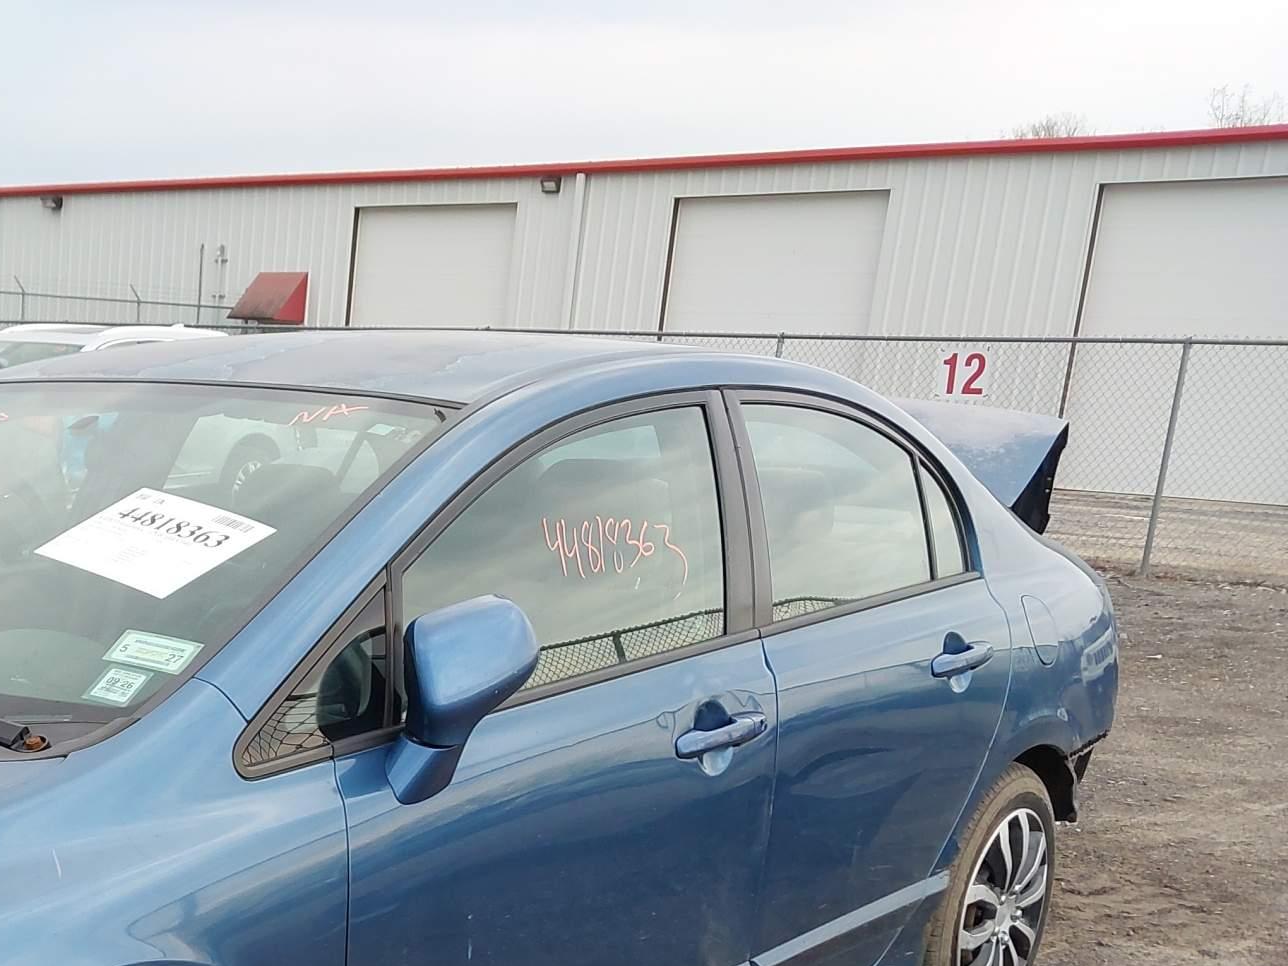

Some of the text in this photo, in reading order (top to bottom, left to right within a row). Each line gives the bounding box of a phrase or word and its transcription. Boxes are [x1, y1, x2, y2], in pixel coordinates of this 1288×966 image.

[943, 352, 986, 395] 12
[118, 507, 231, 549] 44818363
[542, 515, 688, 600] 44818363
[119, 643, 130, 653] 5
[165, 653, 184, 664] 27
